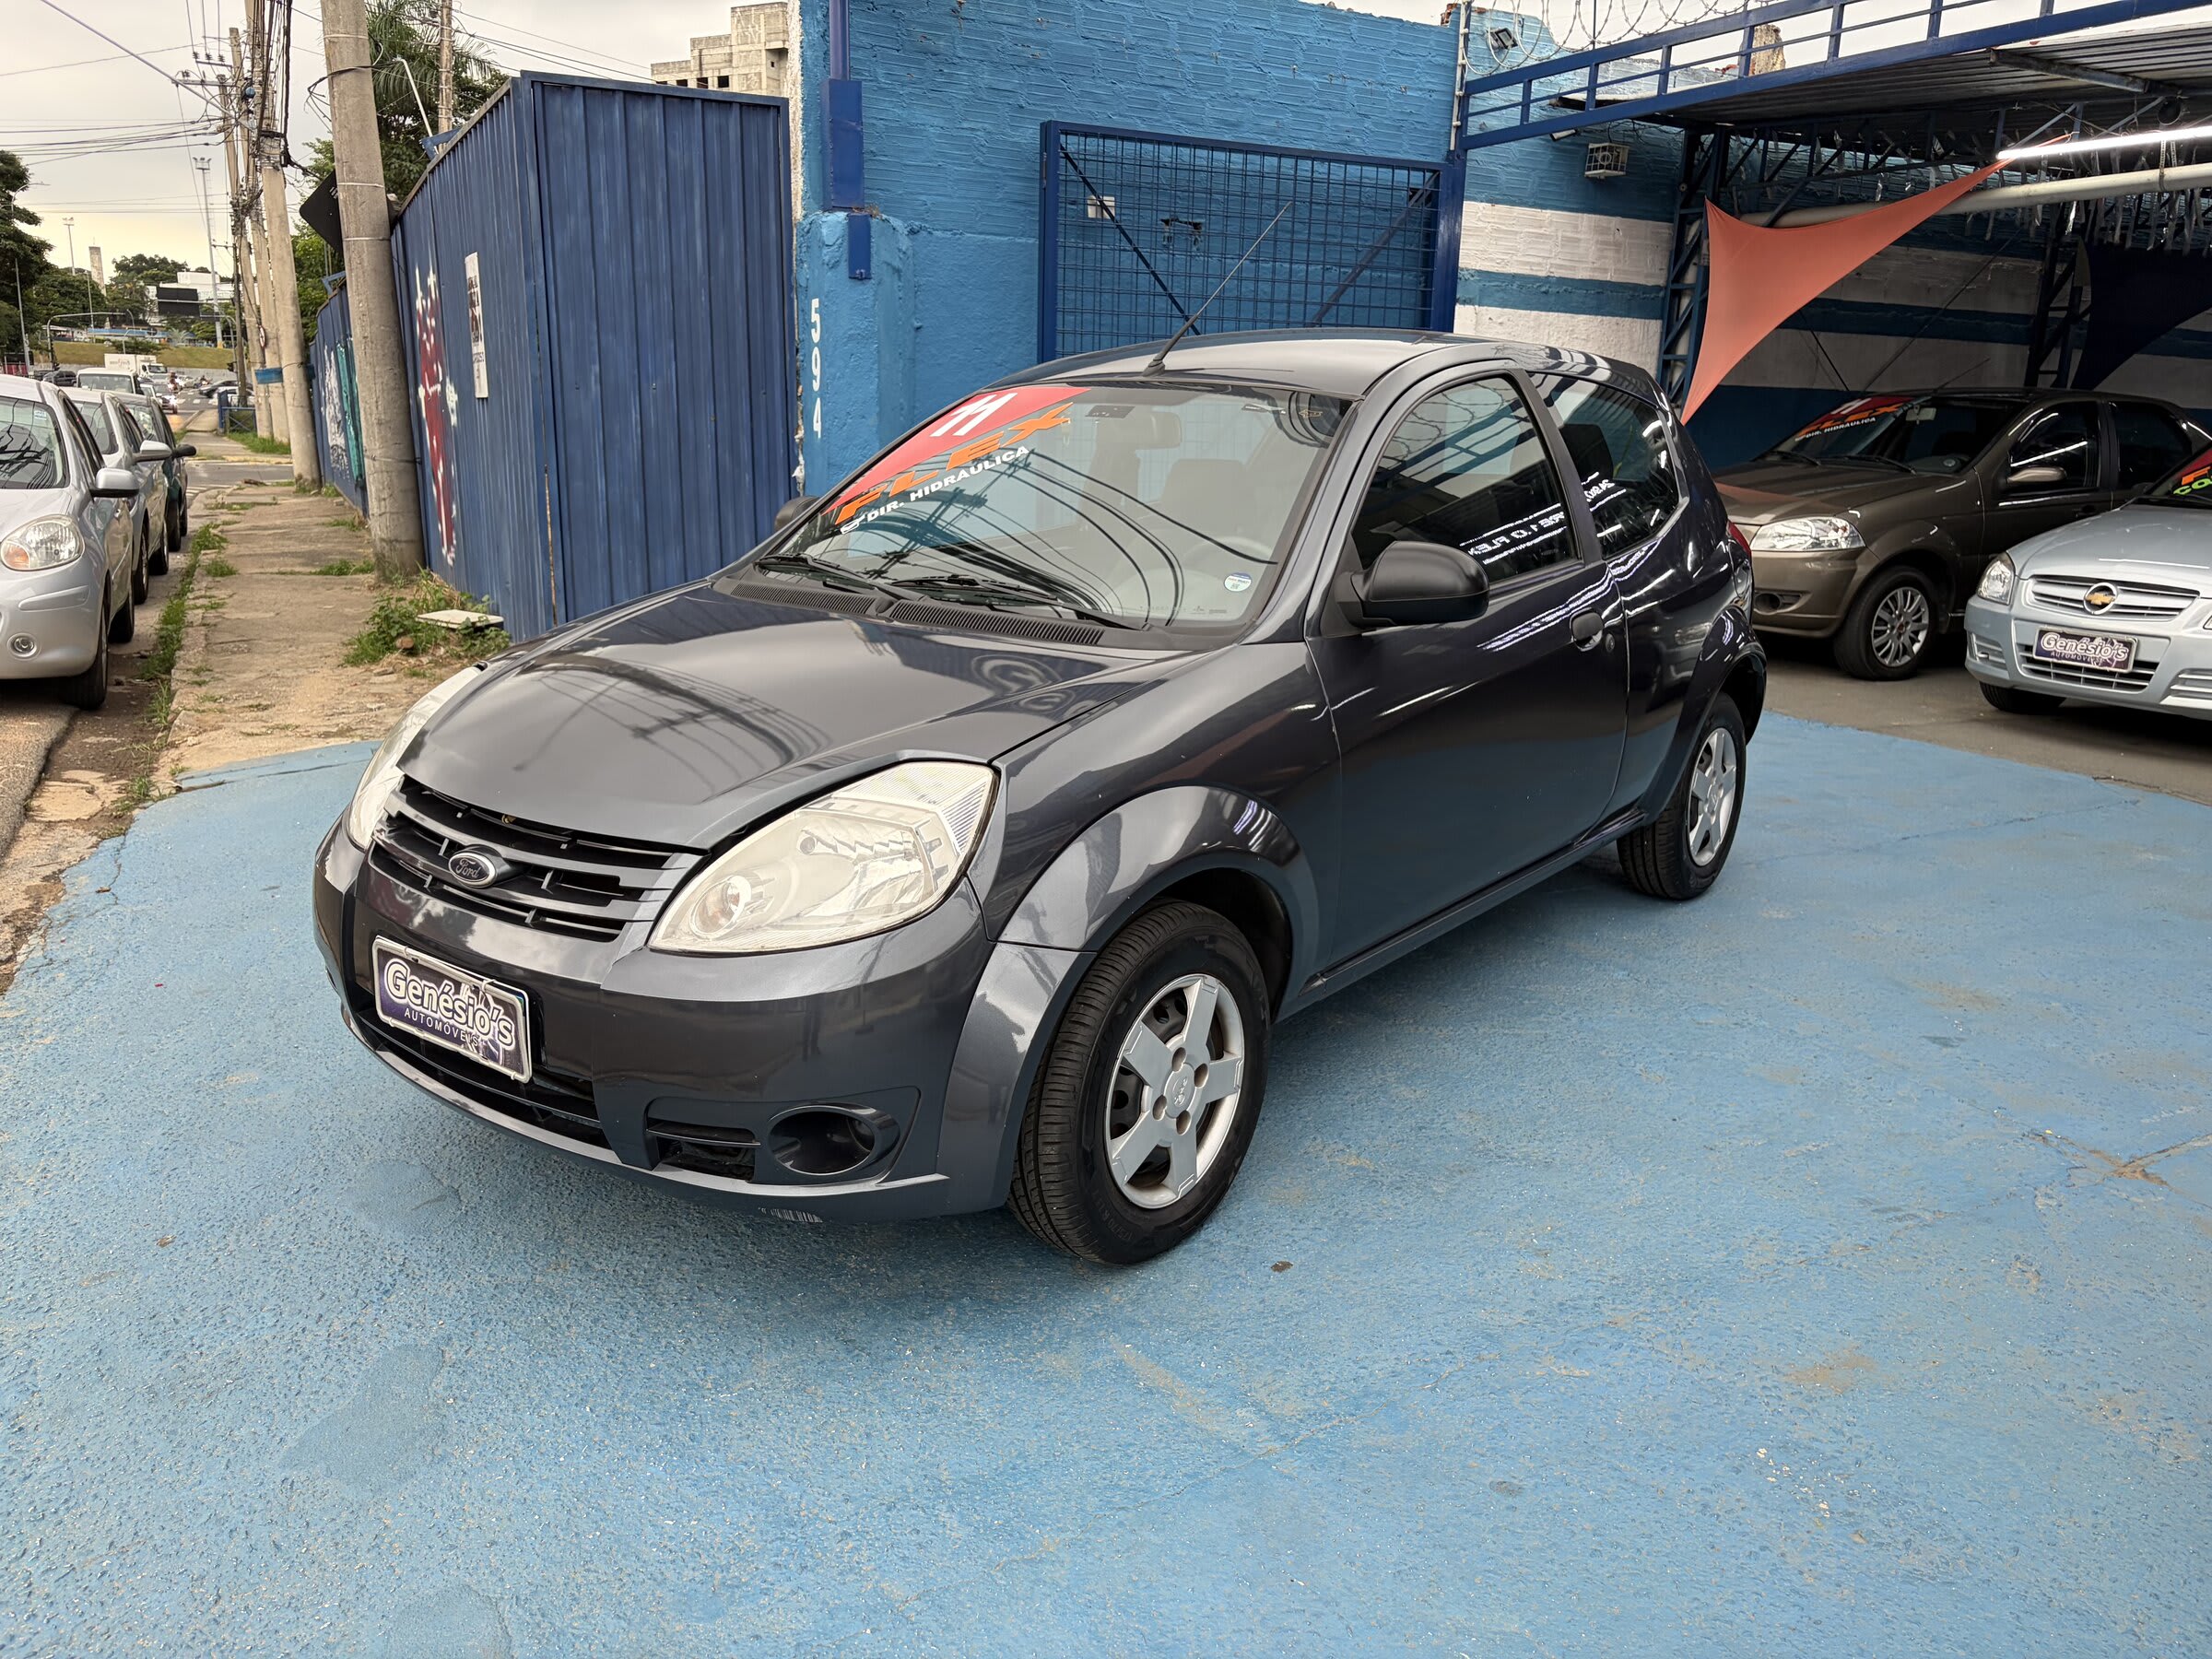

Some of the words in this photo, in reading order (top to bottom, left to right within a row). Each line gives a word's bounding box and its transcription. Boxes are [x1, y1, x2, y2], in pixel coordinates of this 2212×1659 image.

[810, 298, 822, 440] 594
[930, 392, 1018, 437] 11
[1798, 403, 1903, 437] FLEX
[834, 402, 1075, 525] FLEX
[2172, 477, 2212, 496] CO
[2041, 631, 2130, 662] Genésio's
[455, 857, 482, 878] Ford
[384, 959, 516, 1051] Genésio's
[404, 1007, 480, 1047] AUTOMÓVEIS
